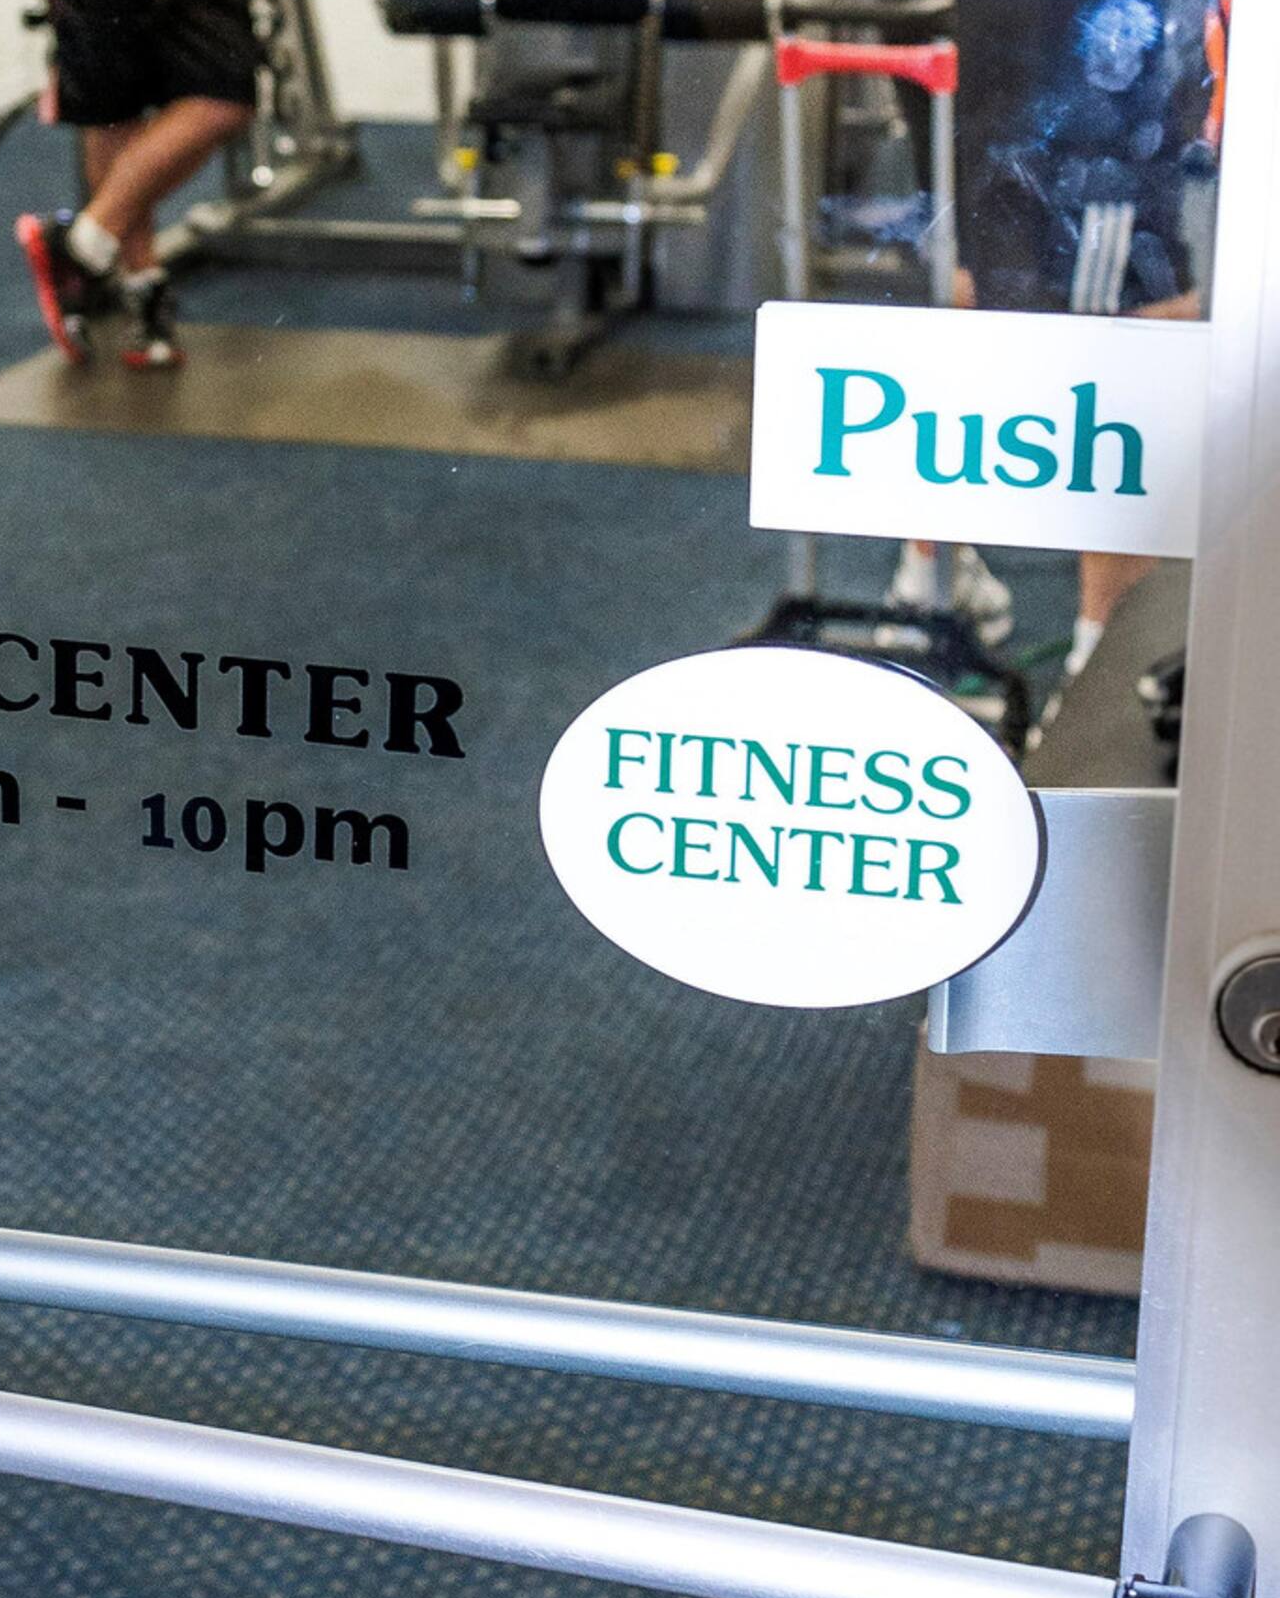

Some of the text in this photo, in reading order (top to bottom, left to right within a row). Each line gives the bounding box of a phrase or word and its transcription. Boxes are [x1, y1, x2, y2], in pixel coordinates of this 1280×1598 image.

[813, 366, 1147, 496] Push
[604, 727, 971, 820] FITNESS
[607, 811, 962, 905] CENTER
